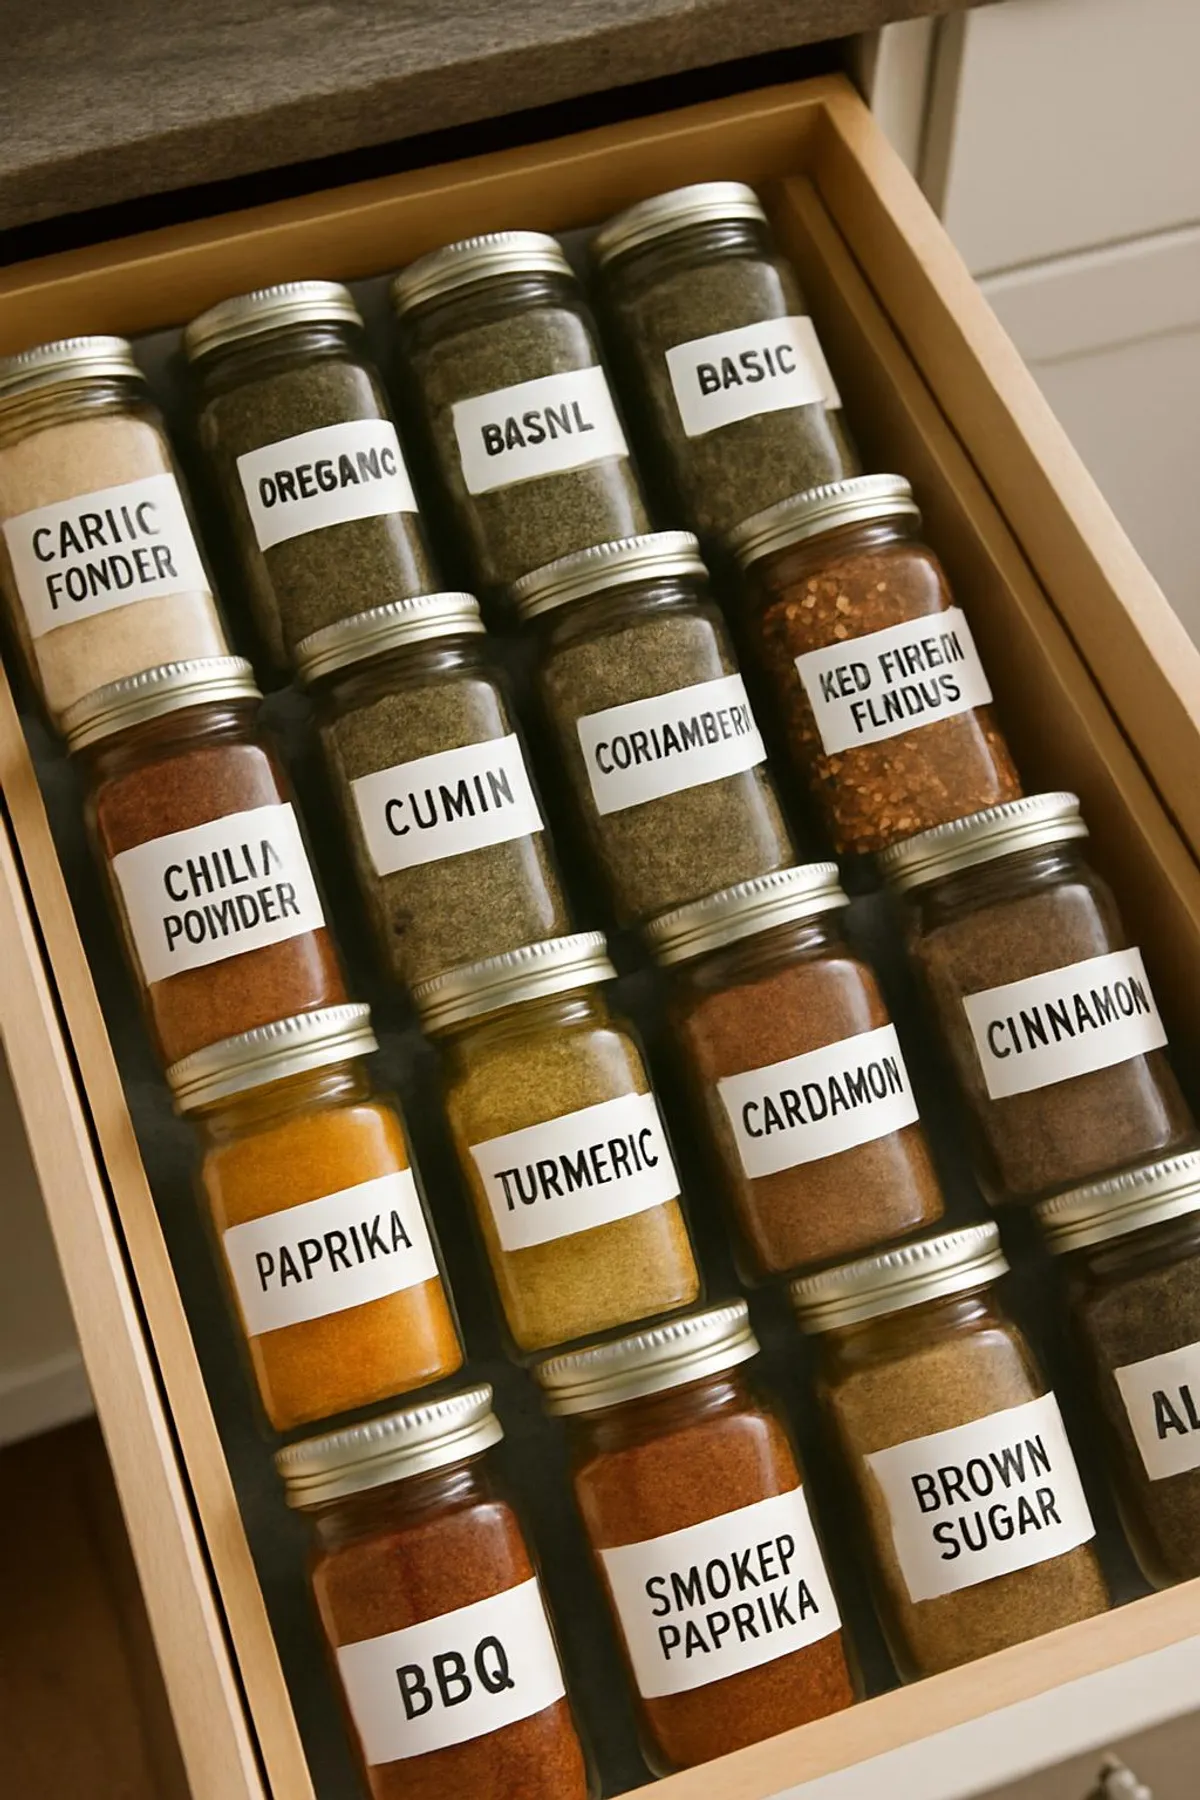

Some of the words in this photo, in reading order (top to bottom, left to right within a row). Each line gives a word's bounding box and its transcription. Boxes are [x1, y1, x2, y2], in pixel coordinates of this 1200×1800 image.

[696, 345, 797, 398] BASIC
[46, 545, 179, 610] FONDER
[388, 768, 515, 838] CUMIN
[987, 977, 1151, 1058] CINNAMON
[742, 1057, 903, 1139] CARDAMON
[495, 1127, 659, 1211] TURMERIC
[255, 1211, 412, 1292] PAPRIKA
[911, 1434, 1051, 1514] BROWN
[932, 1488, 1061, 1561] SUGAR
[645, 1534, 795, 1617] SMOKEP
[658, 1578, 819, 1661] PAPRIKA
[396, 1636, 515, 1721] BBQ
